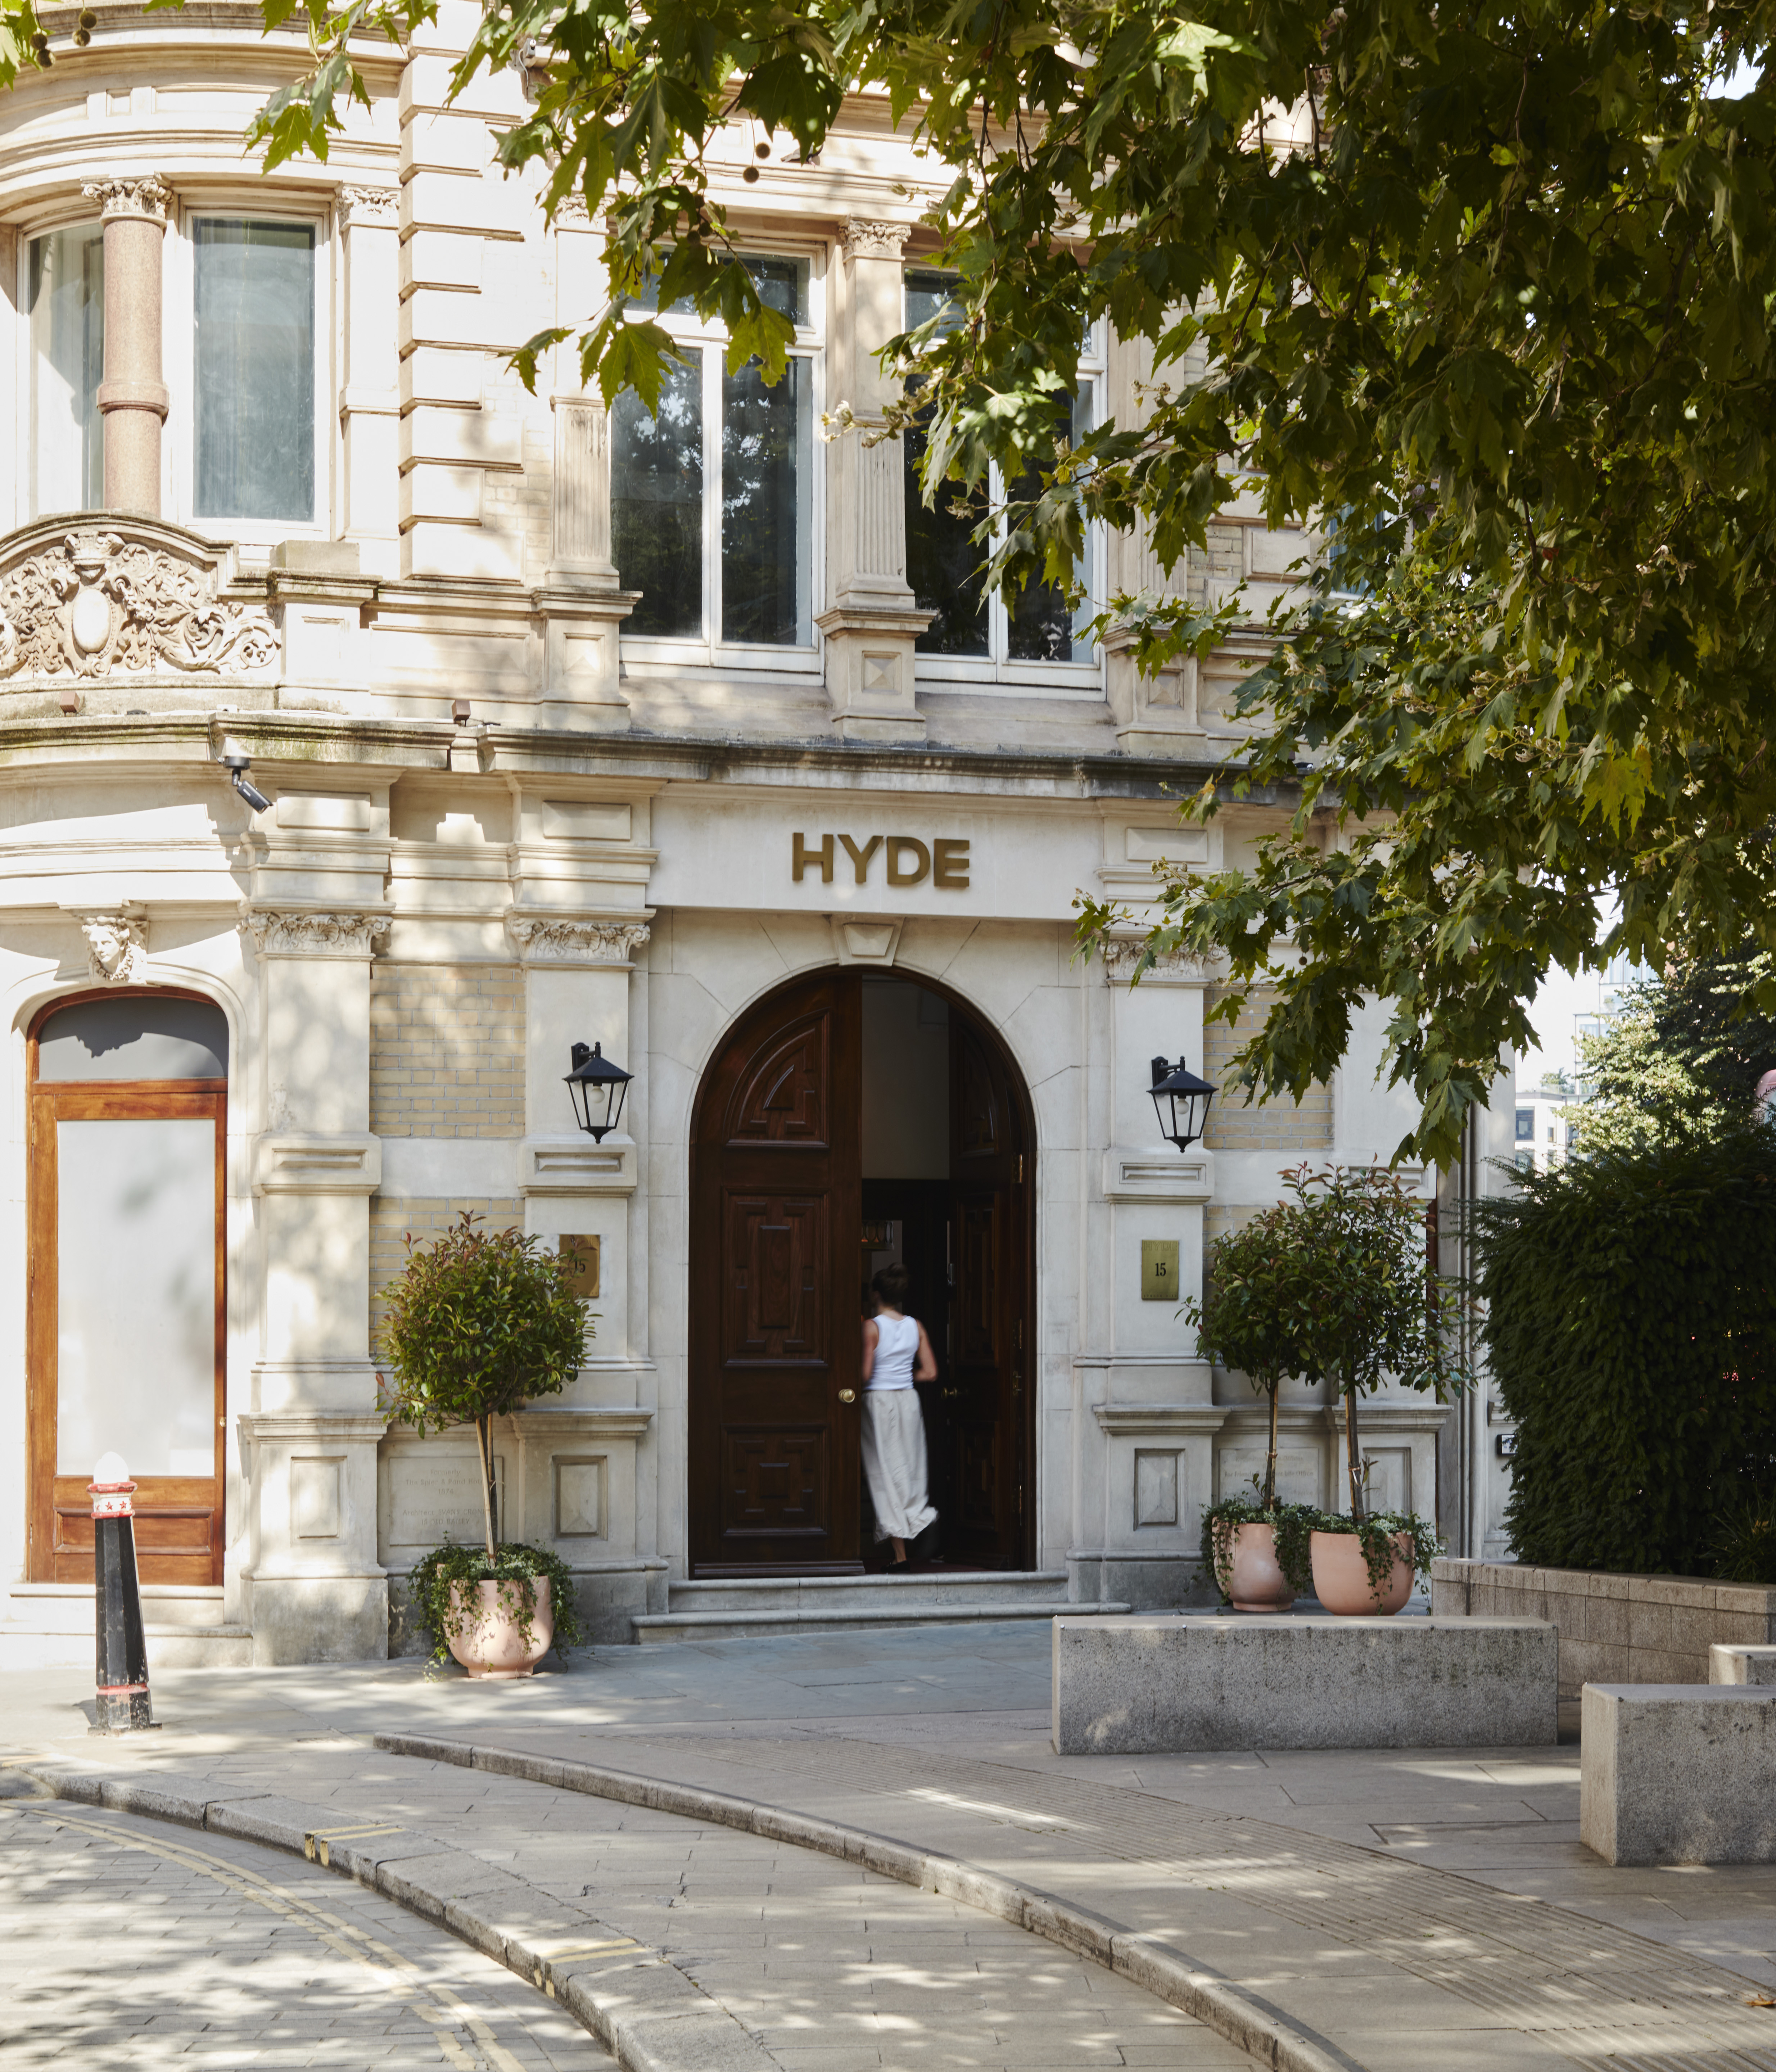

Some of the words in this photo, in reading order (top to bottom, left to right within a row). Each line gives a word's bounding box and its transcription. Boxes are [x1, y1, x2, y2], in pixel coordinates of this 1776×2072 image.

[792, 832, 970, 886] HYDE
[1144, 1241, 1178, 1251] HYDE
[1155, 1262, 1166, 1277] 15
